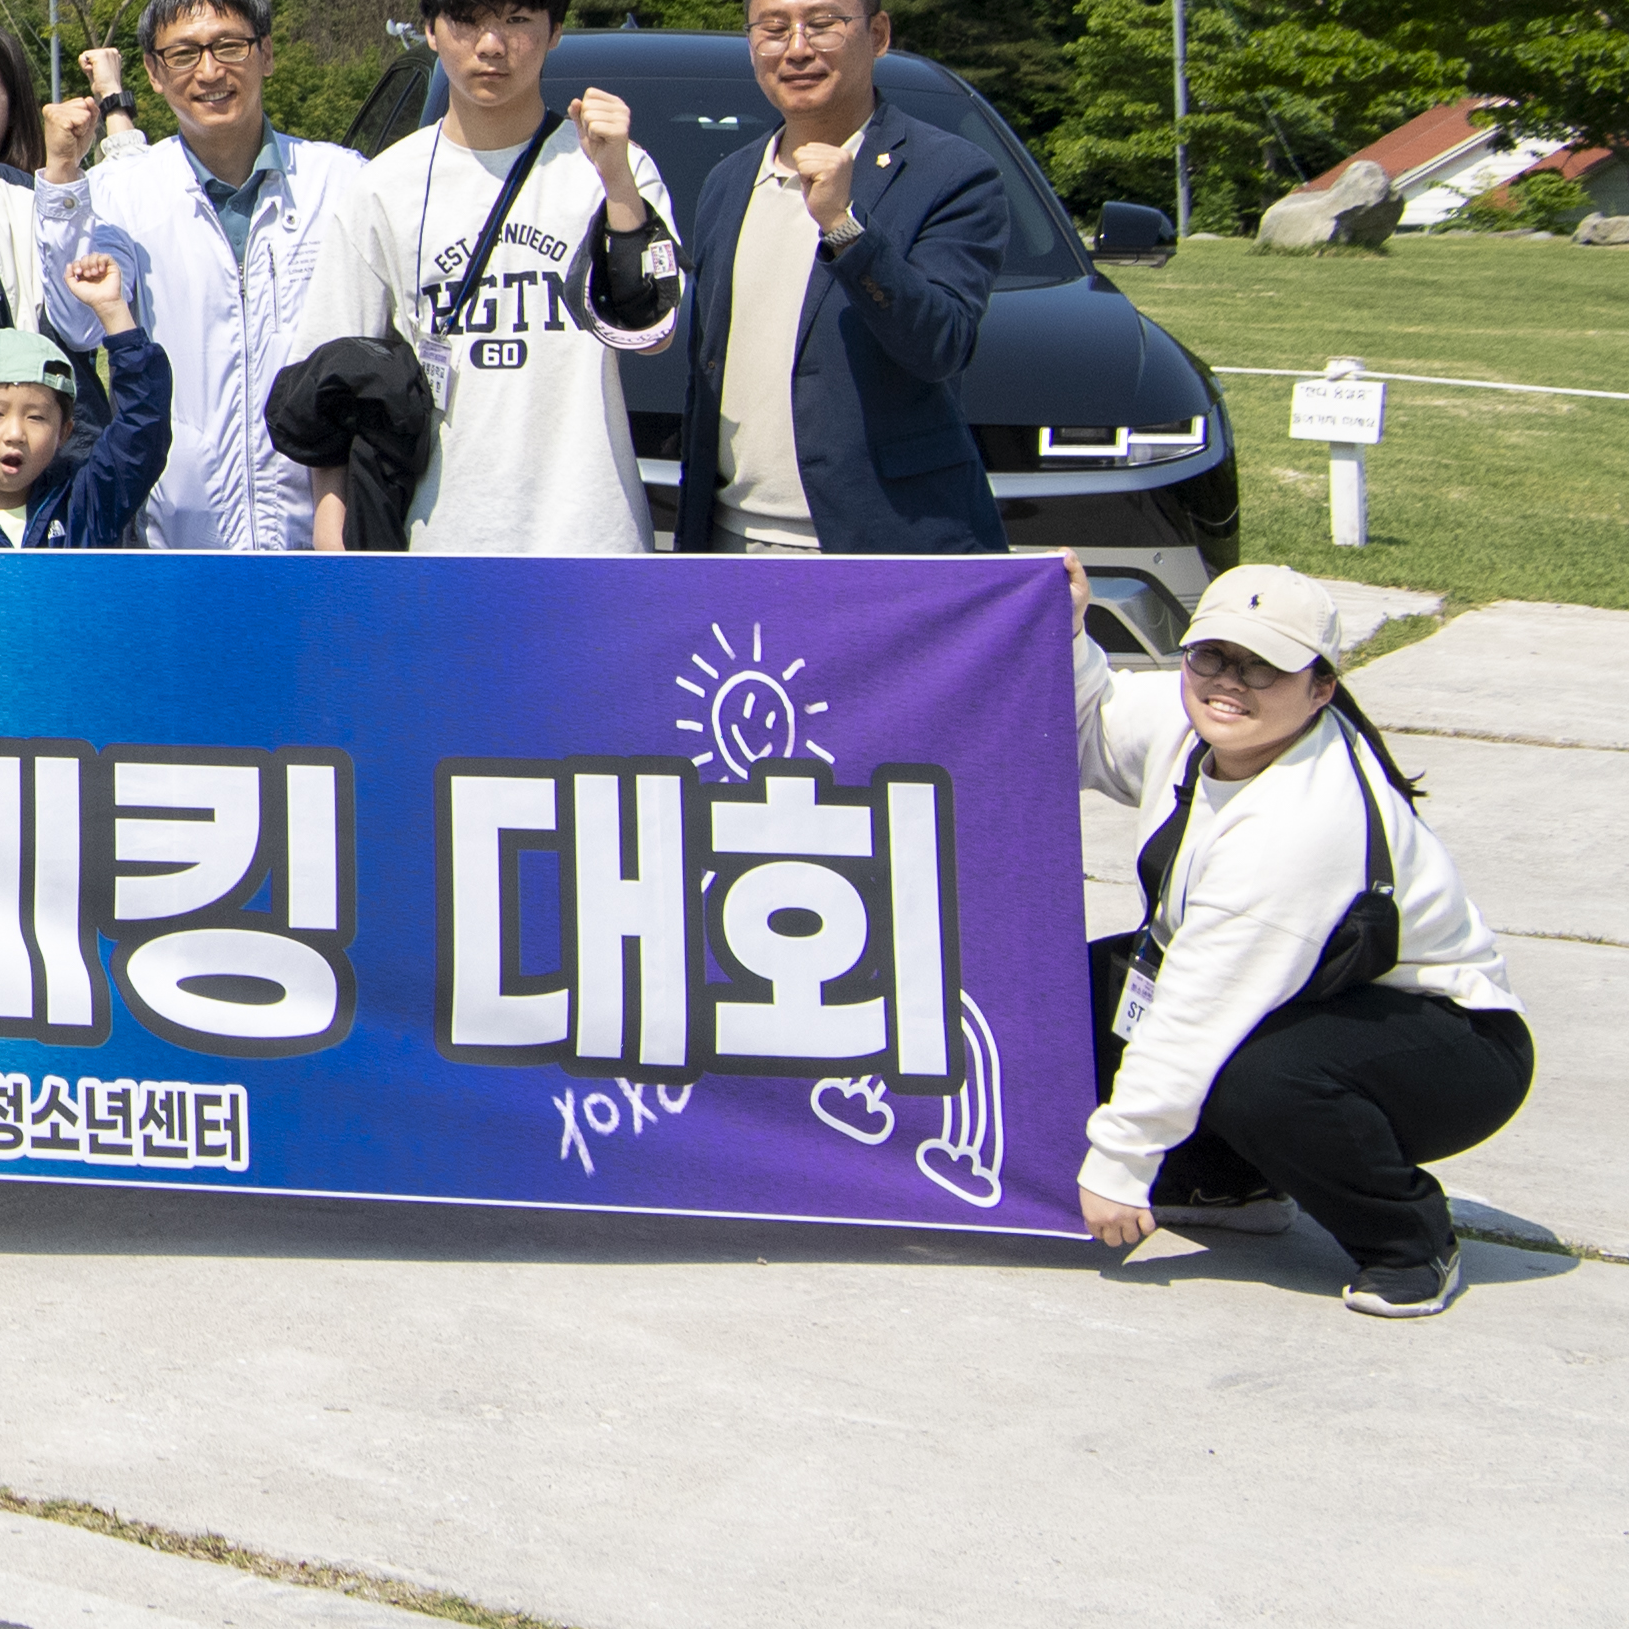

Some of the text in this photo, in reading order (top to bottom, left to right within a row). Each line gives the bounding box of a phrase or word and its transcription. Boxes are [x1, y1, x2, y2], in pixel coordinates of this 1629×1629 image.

[434, 238, 472, 274] EST
[482, 343, 519, 367] 60
[447, 762, 953, 1078] 대회
